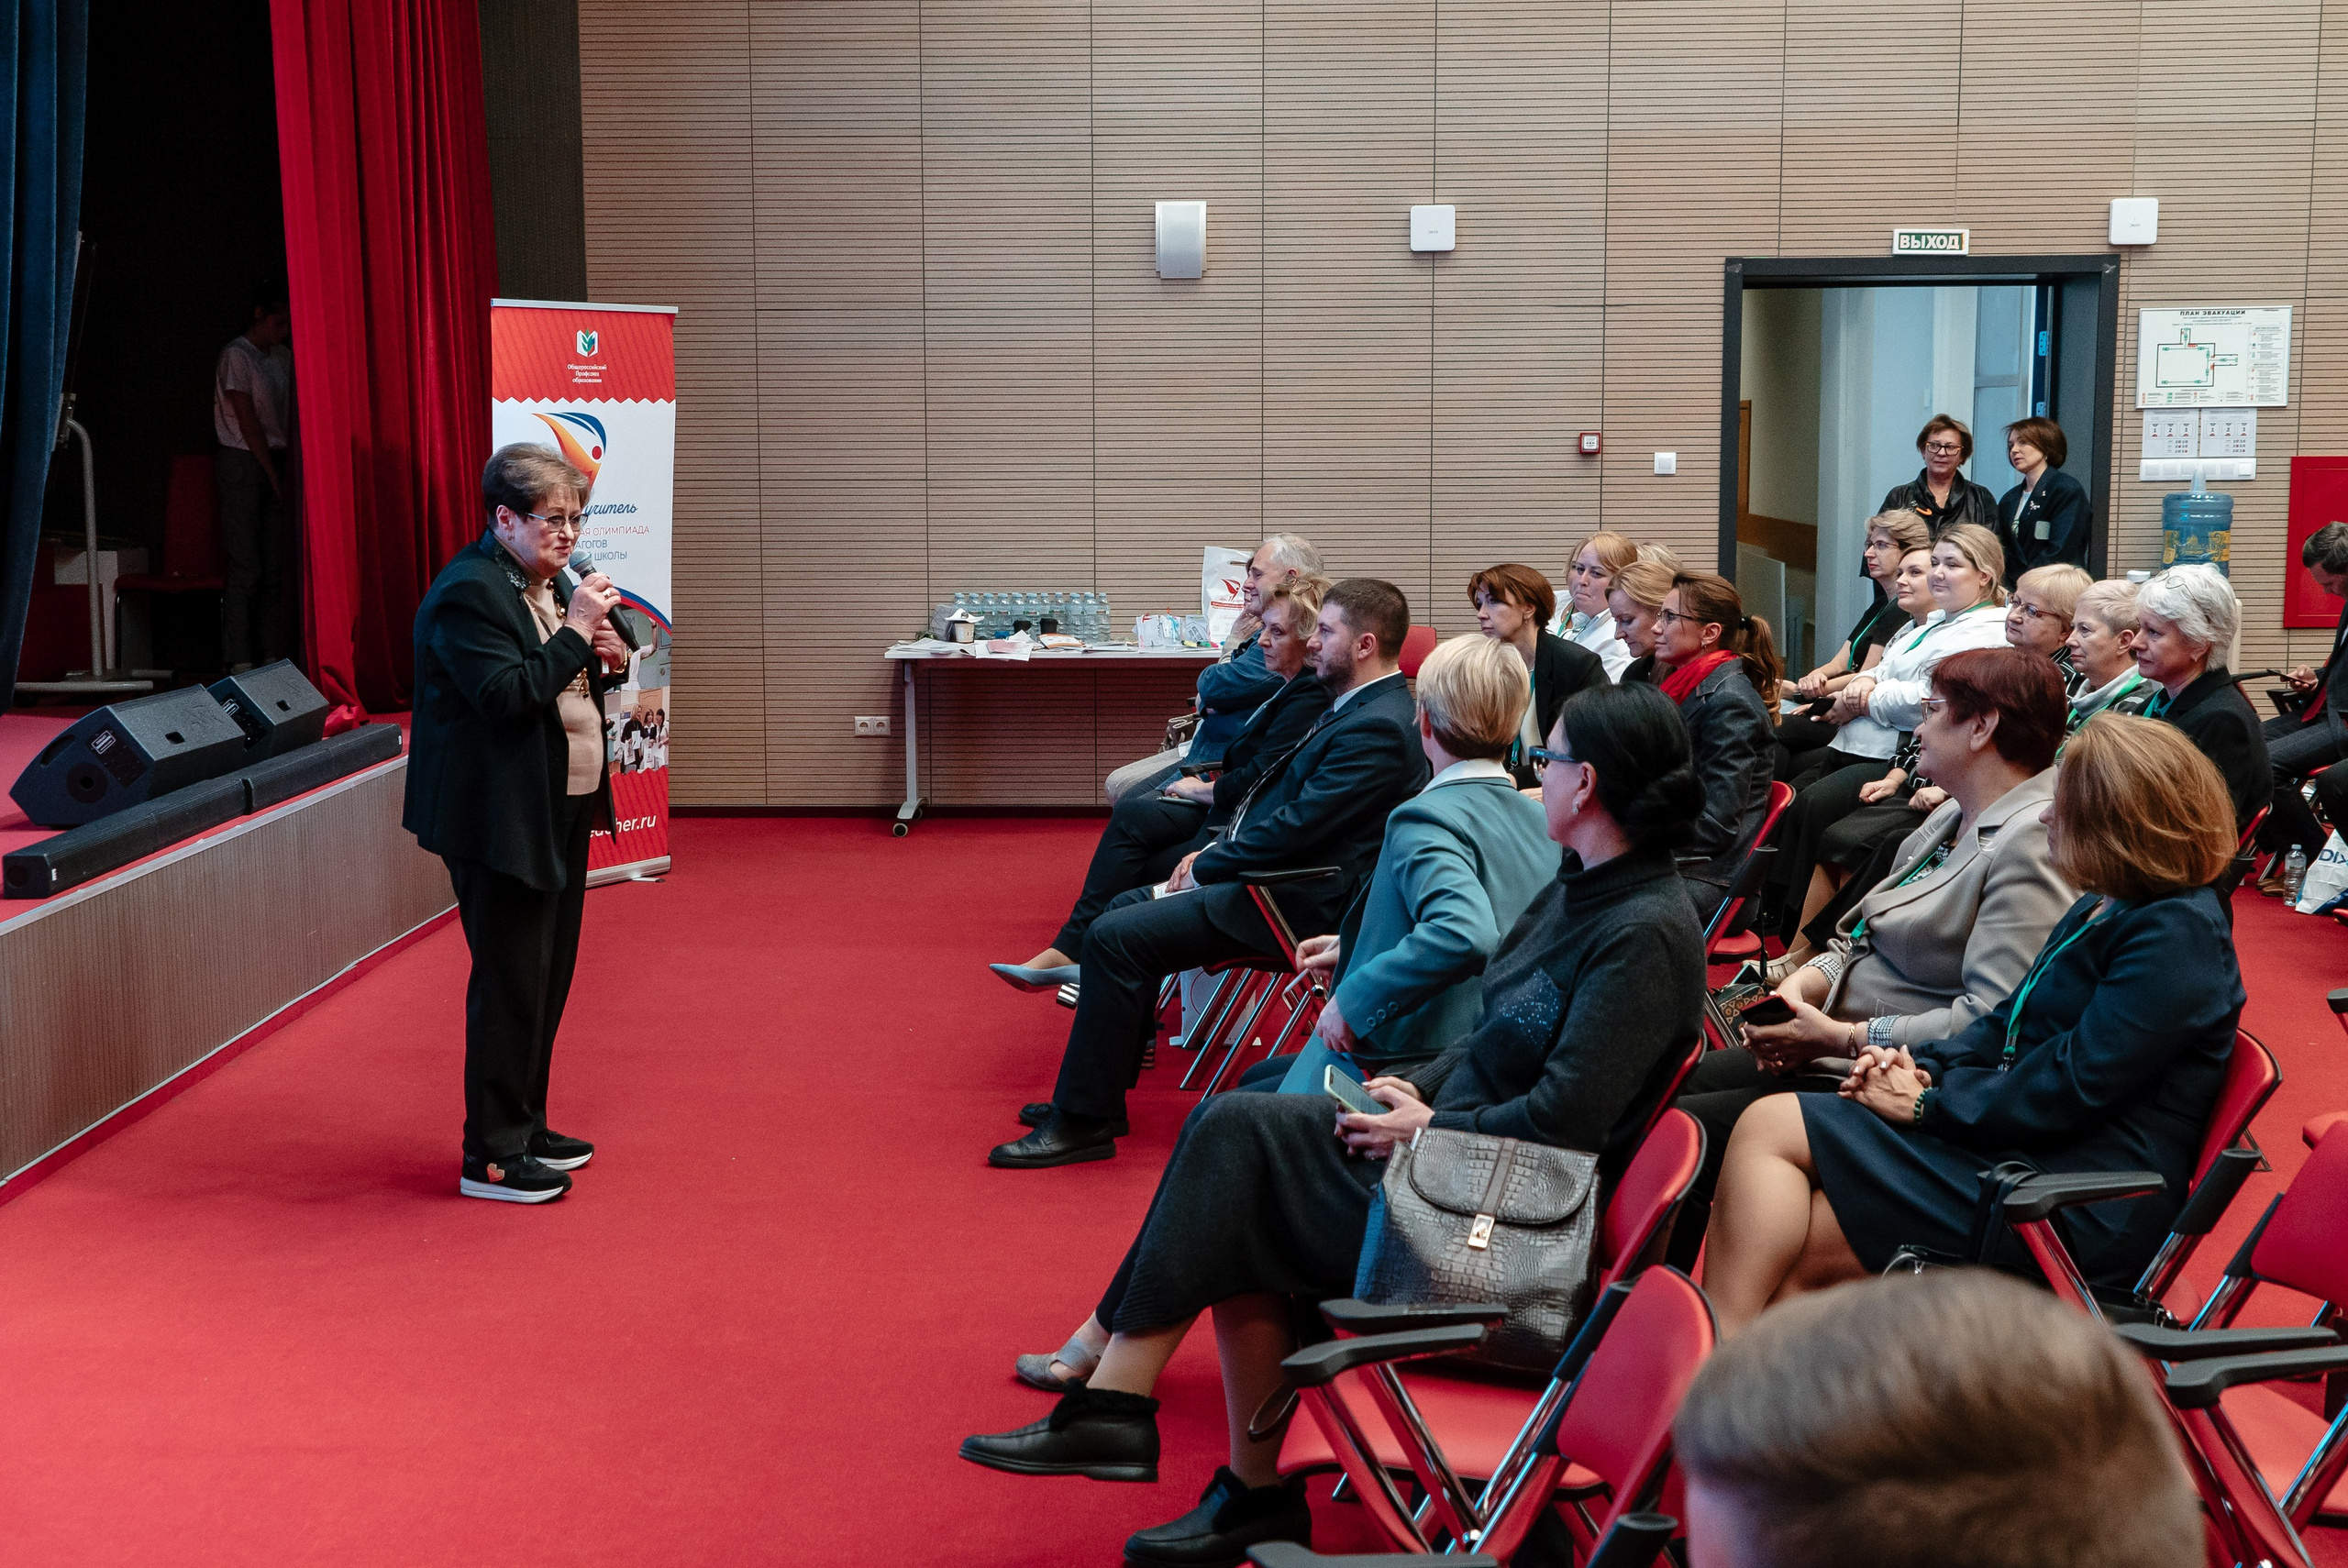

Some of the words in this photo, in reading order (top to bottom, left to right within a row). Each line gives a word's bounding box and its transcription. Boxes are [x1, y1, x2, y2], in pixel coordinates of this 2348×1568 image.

[1899, 235, 1960, 249] ВЫХОД
[584, 503, 638, 515] учитель
[593, 525, 650, 536] ОЛИМПИАДА
[575, 539, 608, 550] АГОГОВ
[594, 551, 627, 561] ШКОЛЫ
